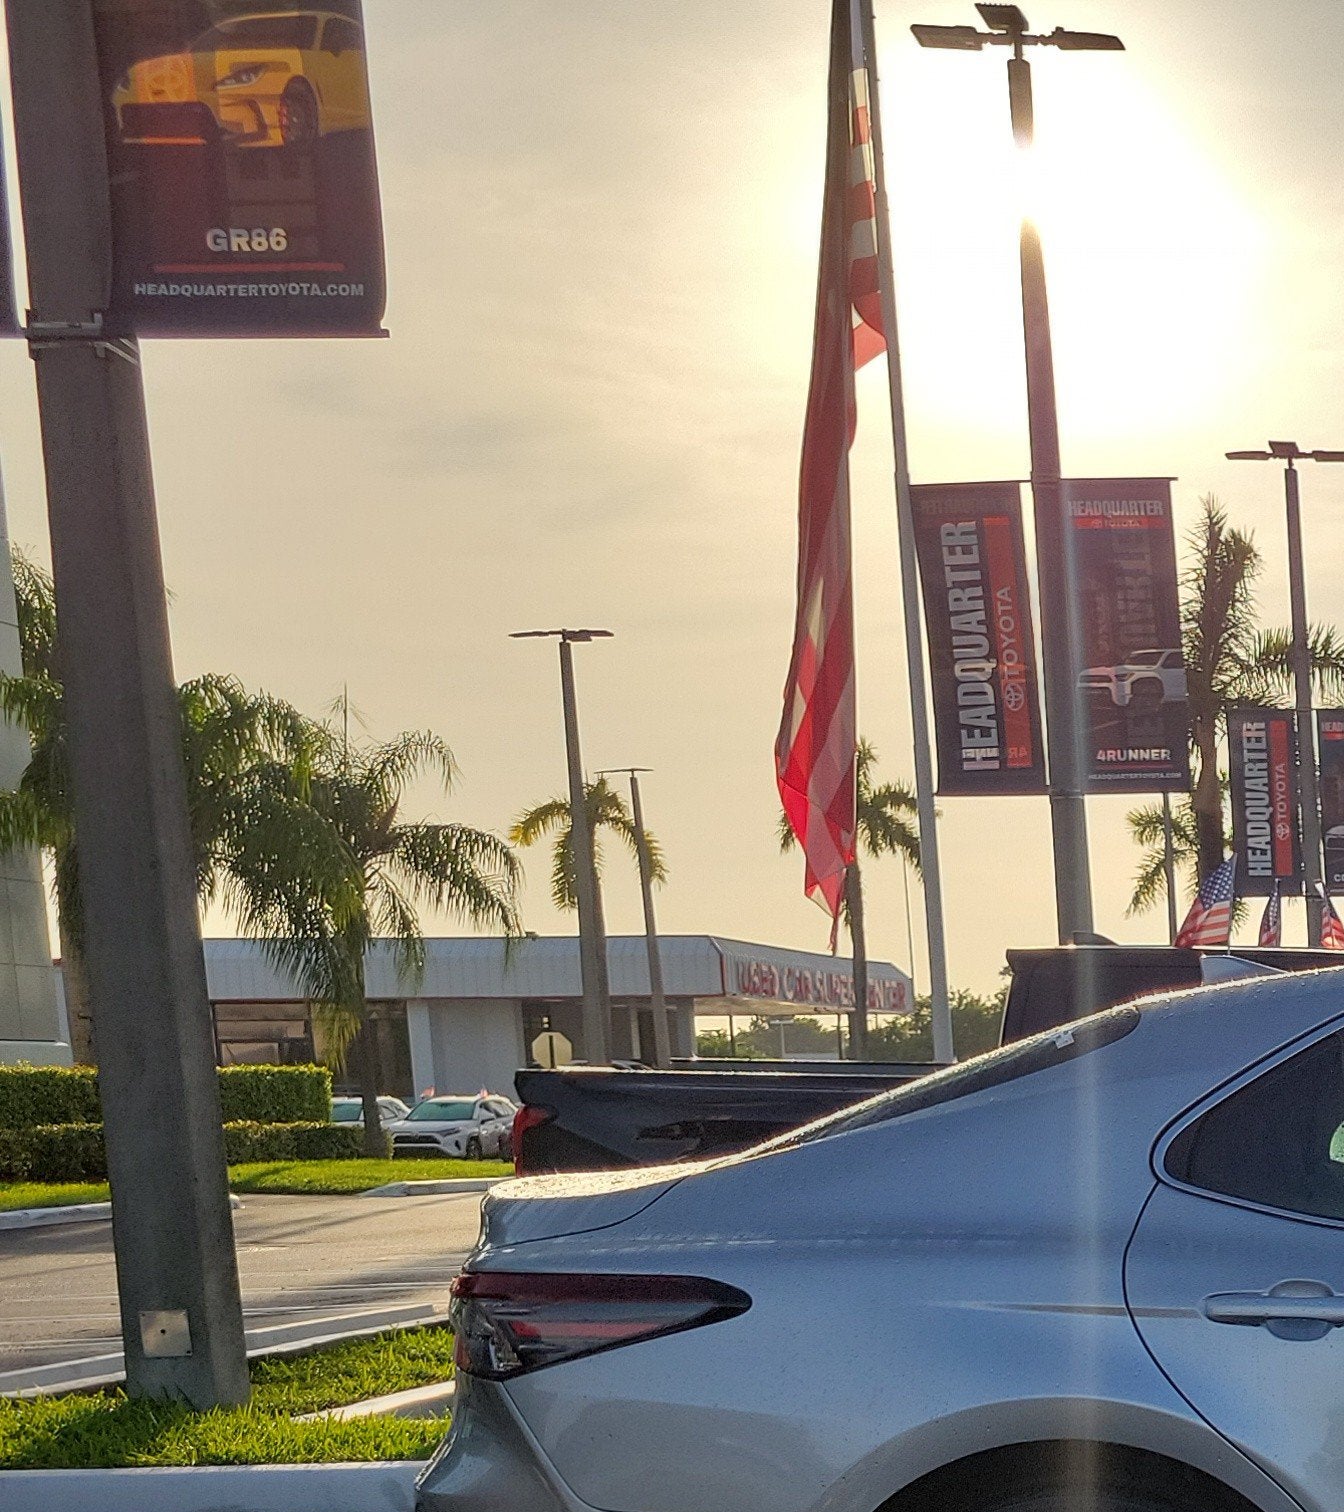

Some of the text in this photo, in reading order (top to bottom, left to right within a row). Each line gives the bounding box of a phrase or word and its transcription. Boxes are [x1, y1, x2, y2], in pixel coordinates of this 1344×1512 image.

[206, 228, 288, 252] GR86
[134, 282, 364, 297] HEADQUARTERTOYOTA.COM
[1068, 500, 1164, 517] HEADQUARTER
[940, 521, 1000, 771] HEADQUARTER
[996, 586, 1019, 680] TOYOTA
[1096, 749, 1171, 761] 4RUNNER
[1243, 722, 1273, 876] HEADQUARTER
[1275, 763, 1288, 820] TOYOTA
[738, 961, 779, 998] USED
[783, 968, 813, 1002] CAR
